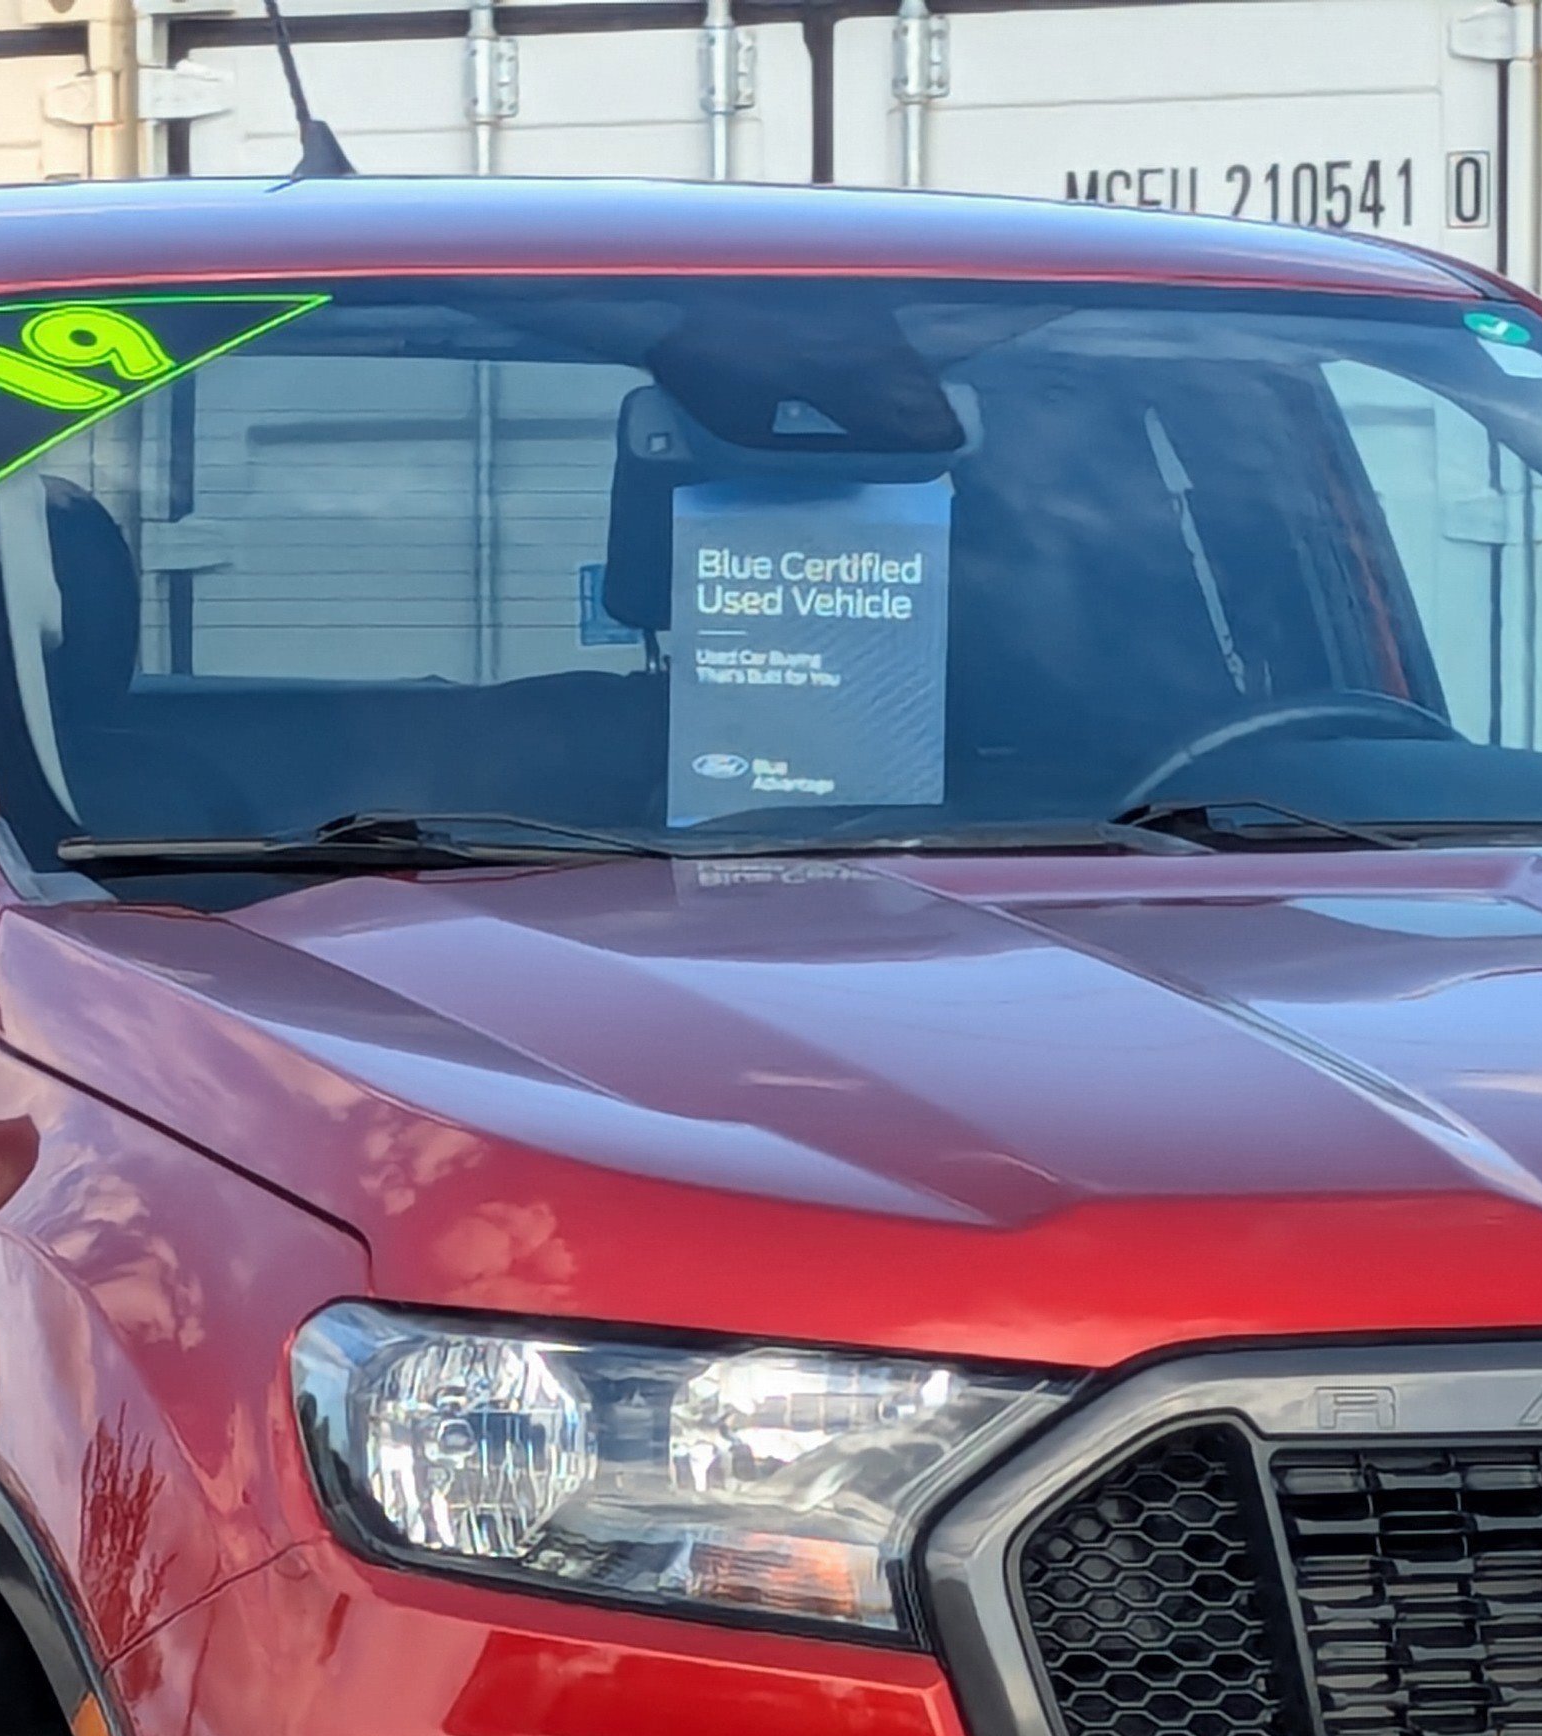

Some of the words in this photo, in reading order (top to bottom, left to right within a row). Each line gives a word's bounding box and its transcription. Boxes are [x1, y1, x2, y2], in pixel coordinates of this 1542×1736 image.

[1225, 157, 1412, 230] 210541
[698, 549, 772, 580] Blue
[780, 551, 922, 584] Certified
[697, 584, 783, 616] Used
[792, 586, 912, 620] Vehicle
